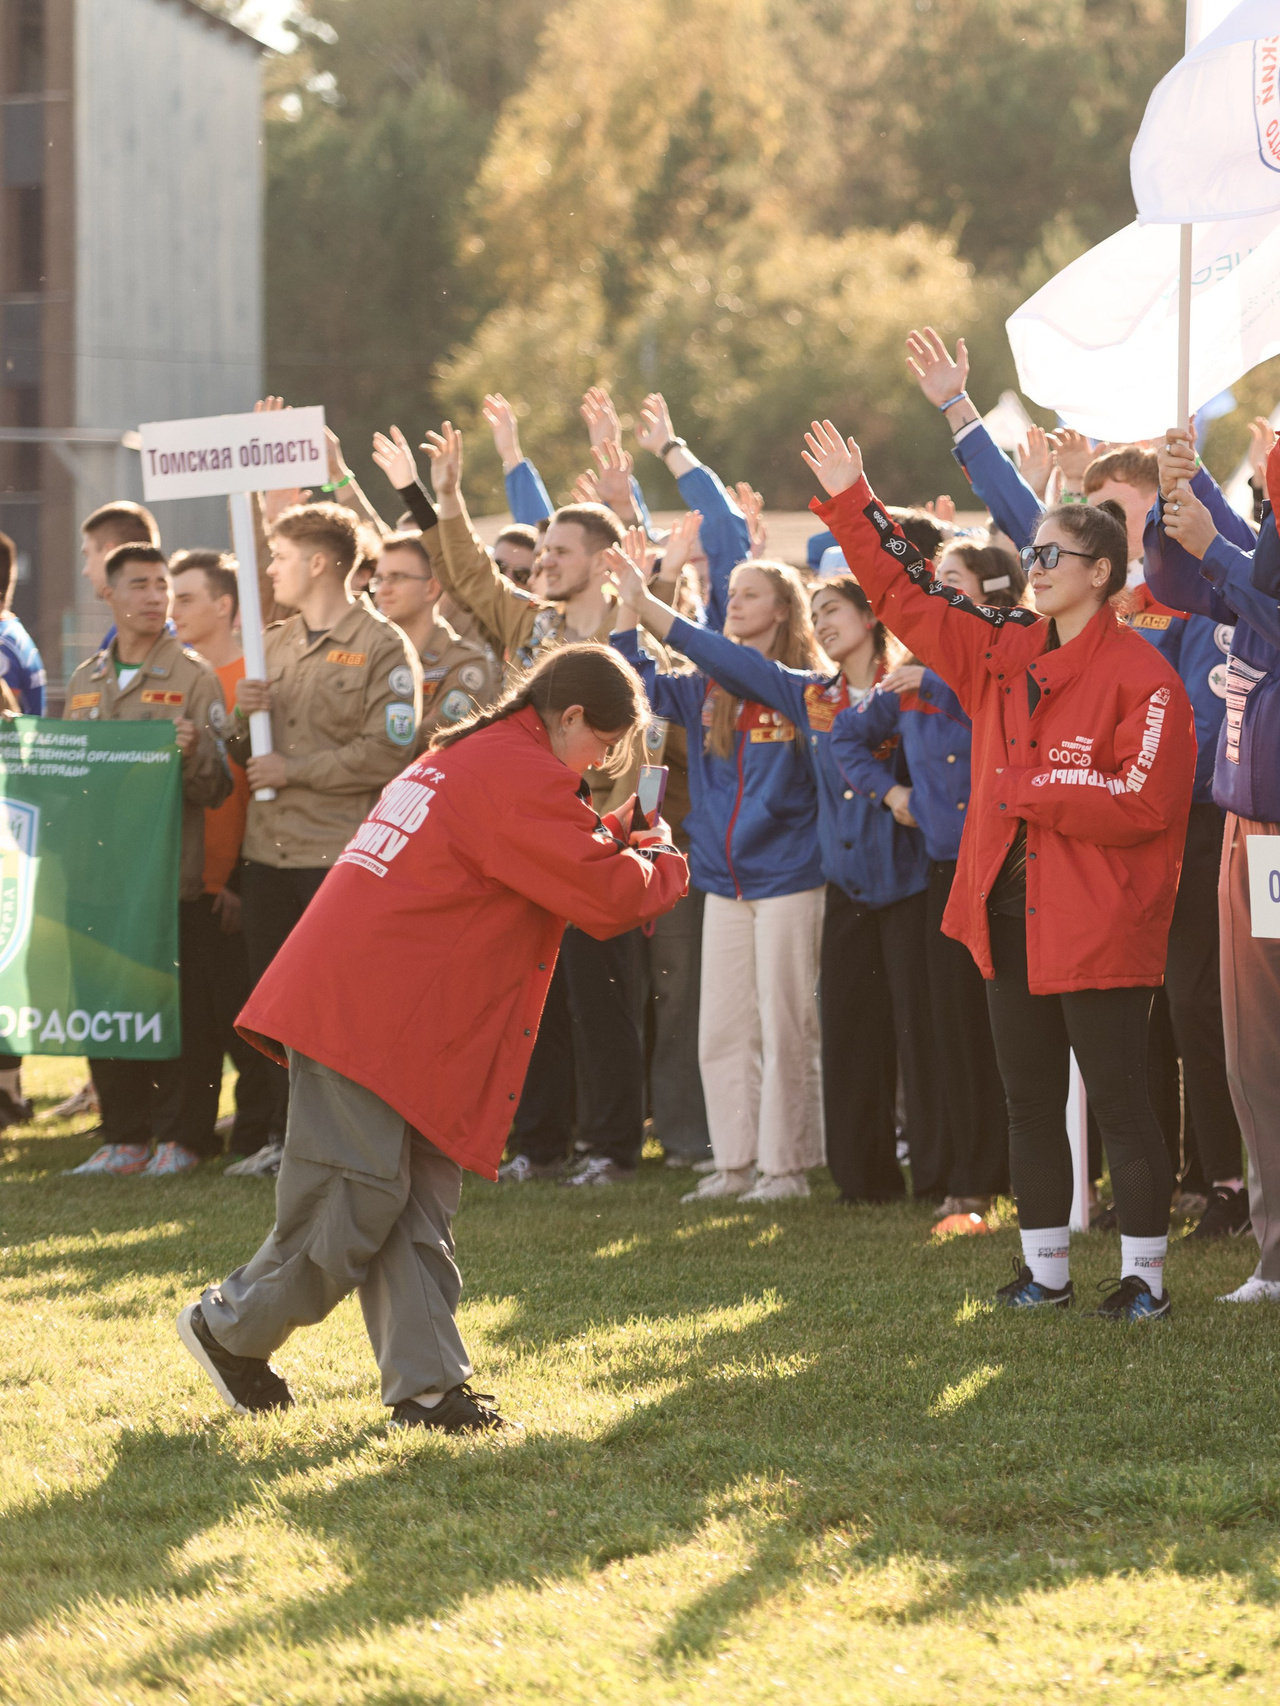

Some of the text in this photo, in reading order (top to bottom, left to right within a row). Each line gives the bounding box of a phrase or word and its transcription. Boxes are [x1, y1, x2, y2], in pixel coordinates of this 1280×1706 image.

[149, 438, 320, 477] Томская область
[1137, 704, 1165, 770] ЛУЧШЕЕ
[87, 751, 170, 764] ОРГАНИЗАЦИИ
